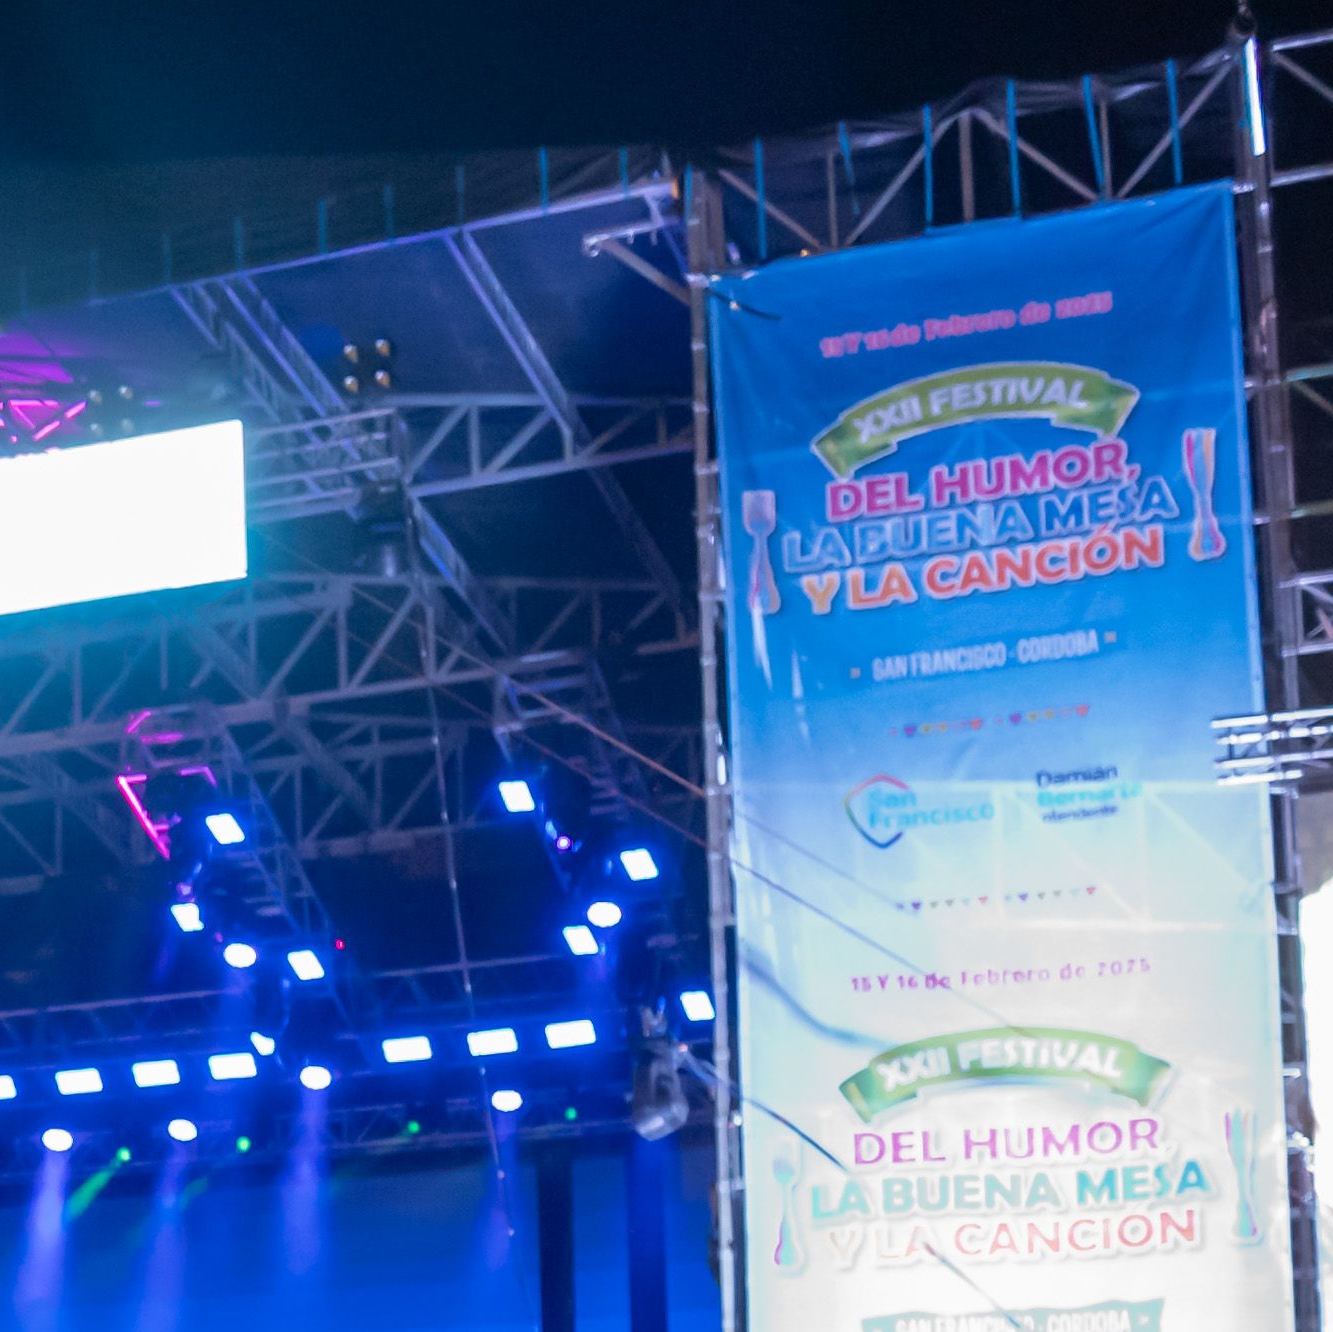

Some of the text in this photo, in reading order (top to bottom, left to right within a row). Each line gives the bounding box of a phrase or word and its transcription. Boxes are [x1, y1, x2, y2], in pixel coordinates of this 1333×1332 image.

[853, 376, 1090, 444] XXII FESTIVAL
[827, 439, 1141, 520] DEL HUMOR,
[783, 474, 1180, 573] LA BUENA MESA
[801, 523, 1165, 616] Y LA CANCIÓN
[872, 655, 908, 681] SAN
[909, 642, 1007, 677] FRANCISCO
[878, 974, 889, 991] Y
[1058, 963, 1085, 981] de
[876, 1036, 1123, 1092] XXII FESTIVAL
[853, 1130, 946, 1165] DEL
[811, 1159, 1210, 1219] LA BUENA MESA
[829, 1231, 856, 1260] Y
[875, 1226, 937, 1260] LA
